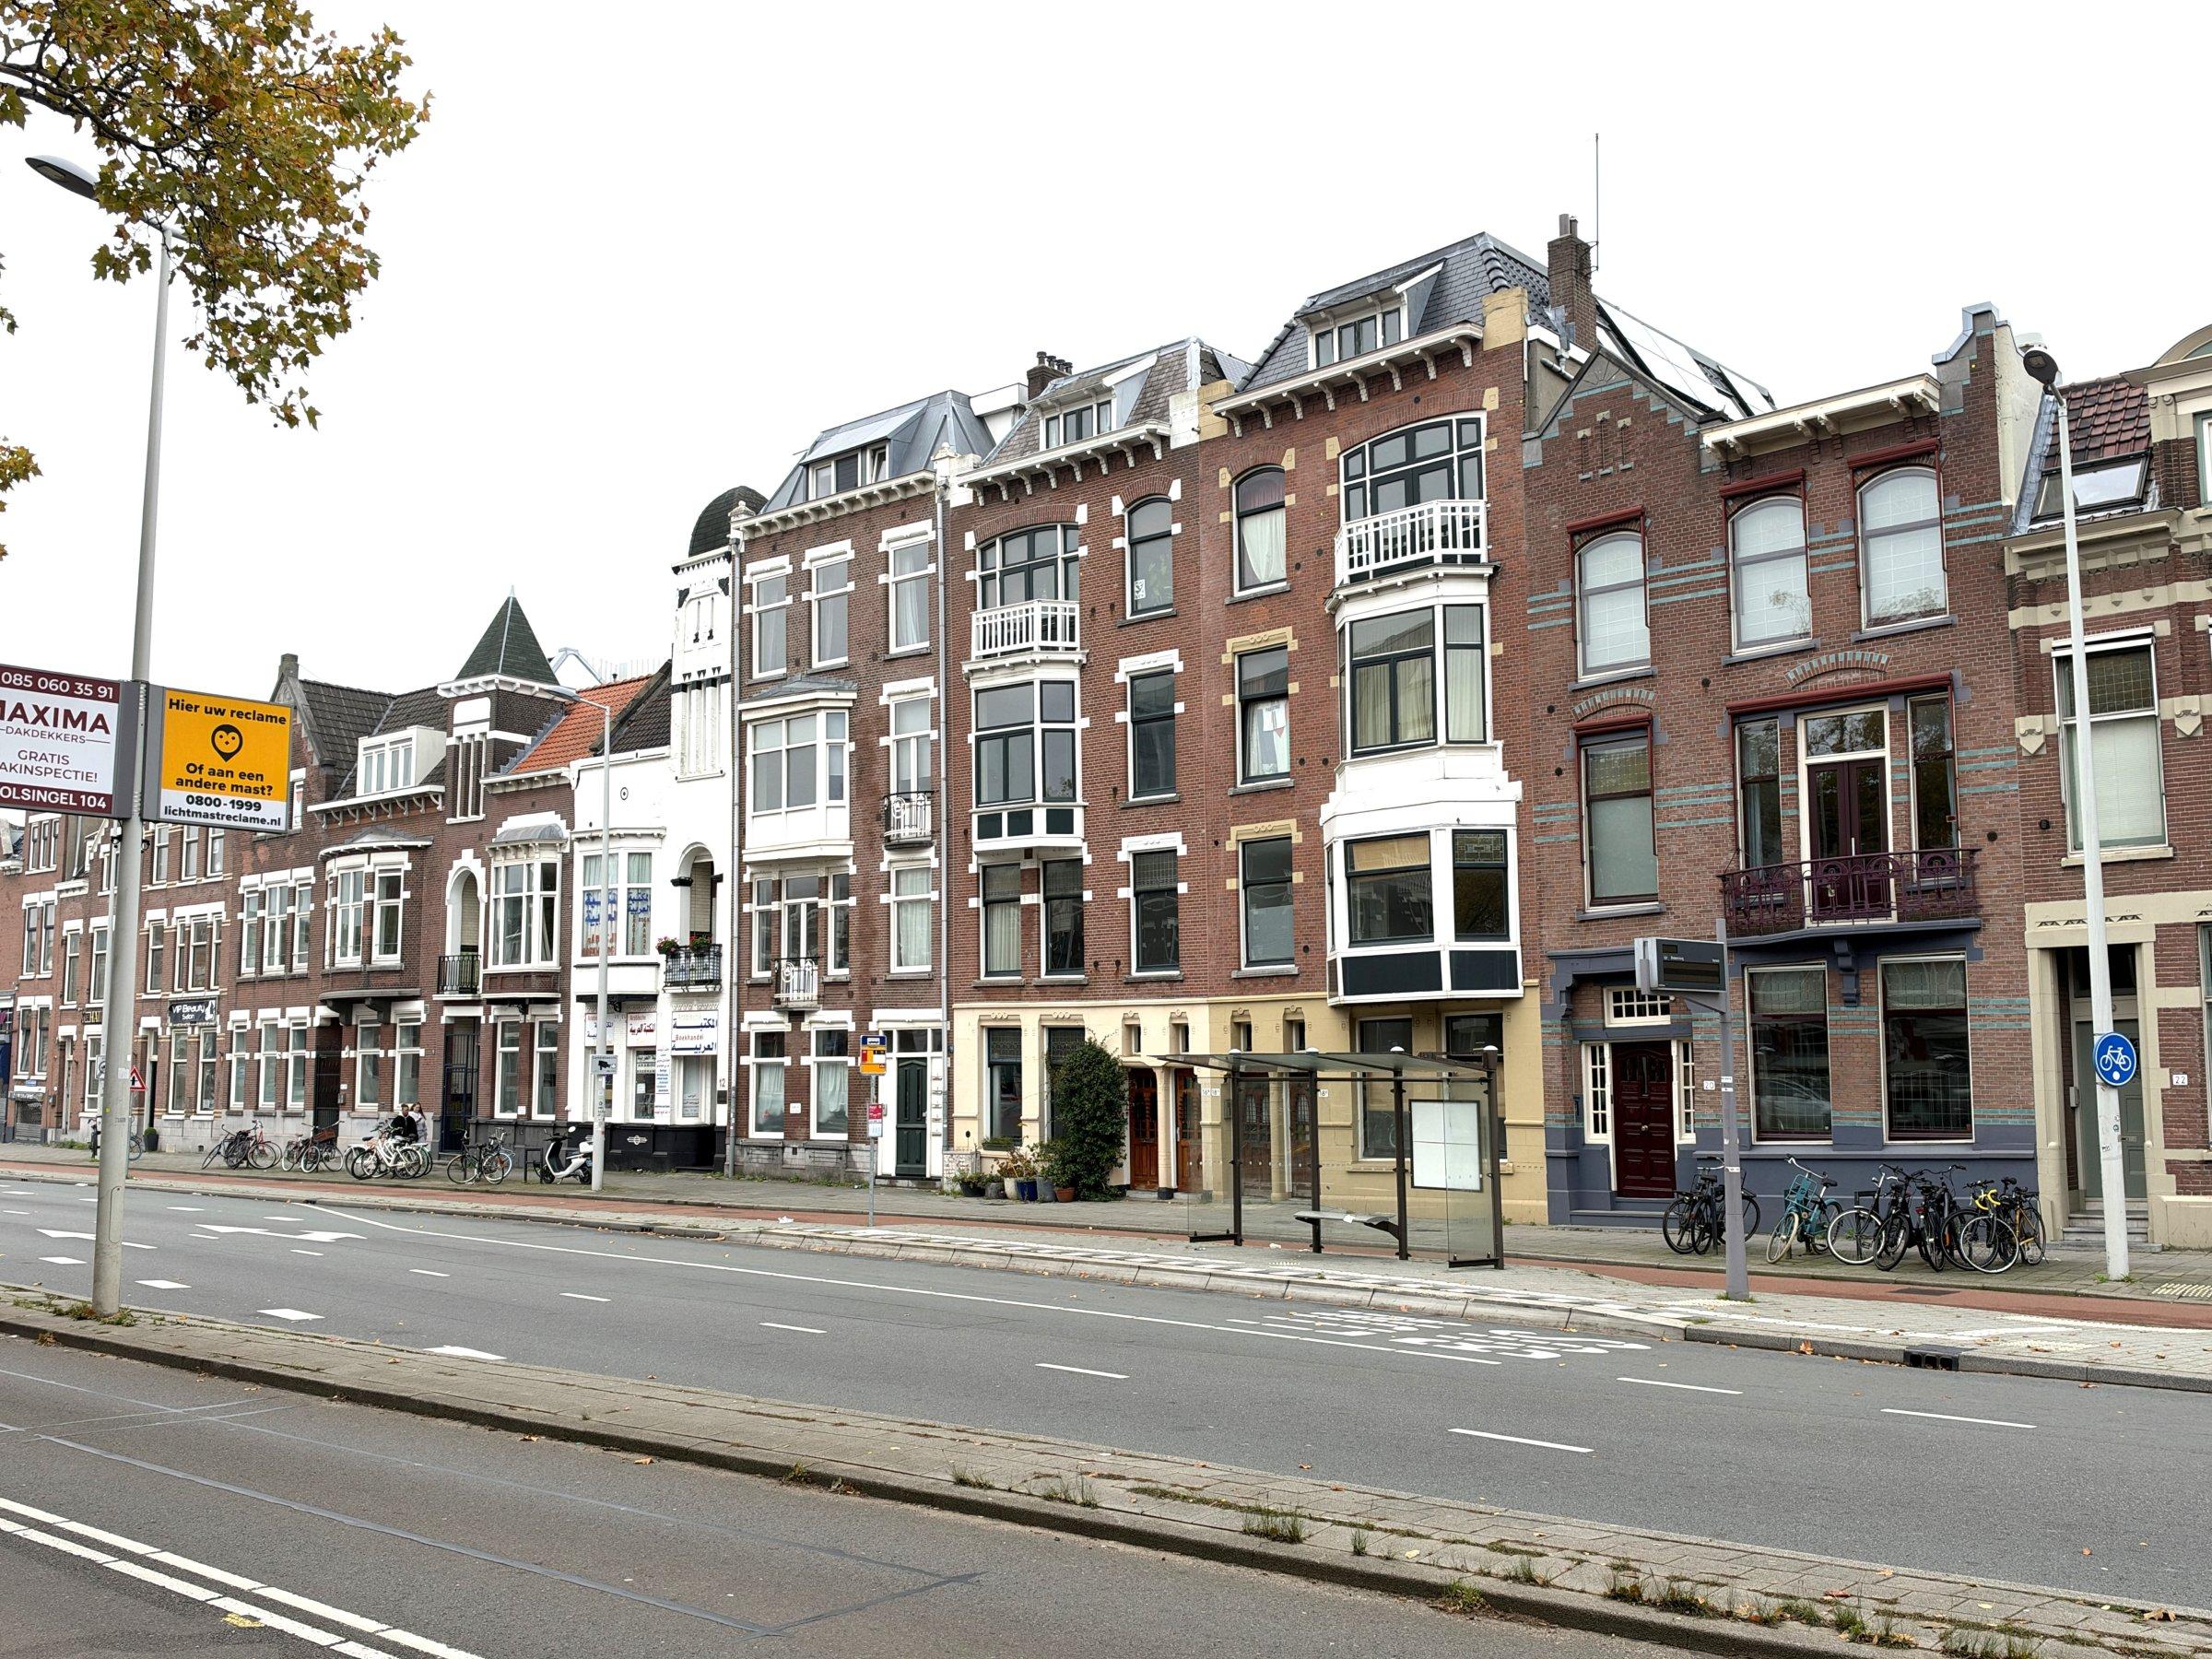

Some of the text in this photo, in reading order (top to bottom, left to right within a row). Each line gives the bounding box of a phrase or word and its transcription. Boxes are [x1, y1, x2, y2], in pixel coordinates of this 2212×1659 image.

[2, 672, 113, 699] 085 060 35 91
[0, 700, 111, 735] AXIMA
[169, 698, 287, 724] Hier uw reclame
[6, 726, 86, 744] DAKDEKKERS
[18, 749, 70, 765] GRATIS
[185, 762, 265, 782] Of aan een
[175, 777, 274, 795] andere mast?
[80, 794, 107, 809] 104
[164, 806, 281, 827] lichtmastreclame.nl
[172, 1005, 206, 1014] VIP Beauty
[673, 1018, 718, 1031] المكتبة
[671, 1040, 717, 1053] العربية
[719, 1078, 726, 1088] 12
[1704, 1081, 1714, 1089] 20
[2174, 1076, 2186, 1084] 22
[1388, 1329, 1653, 1359] BUS
